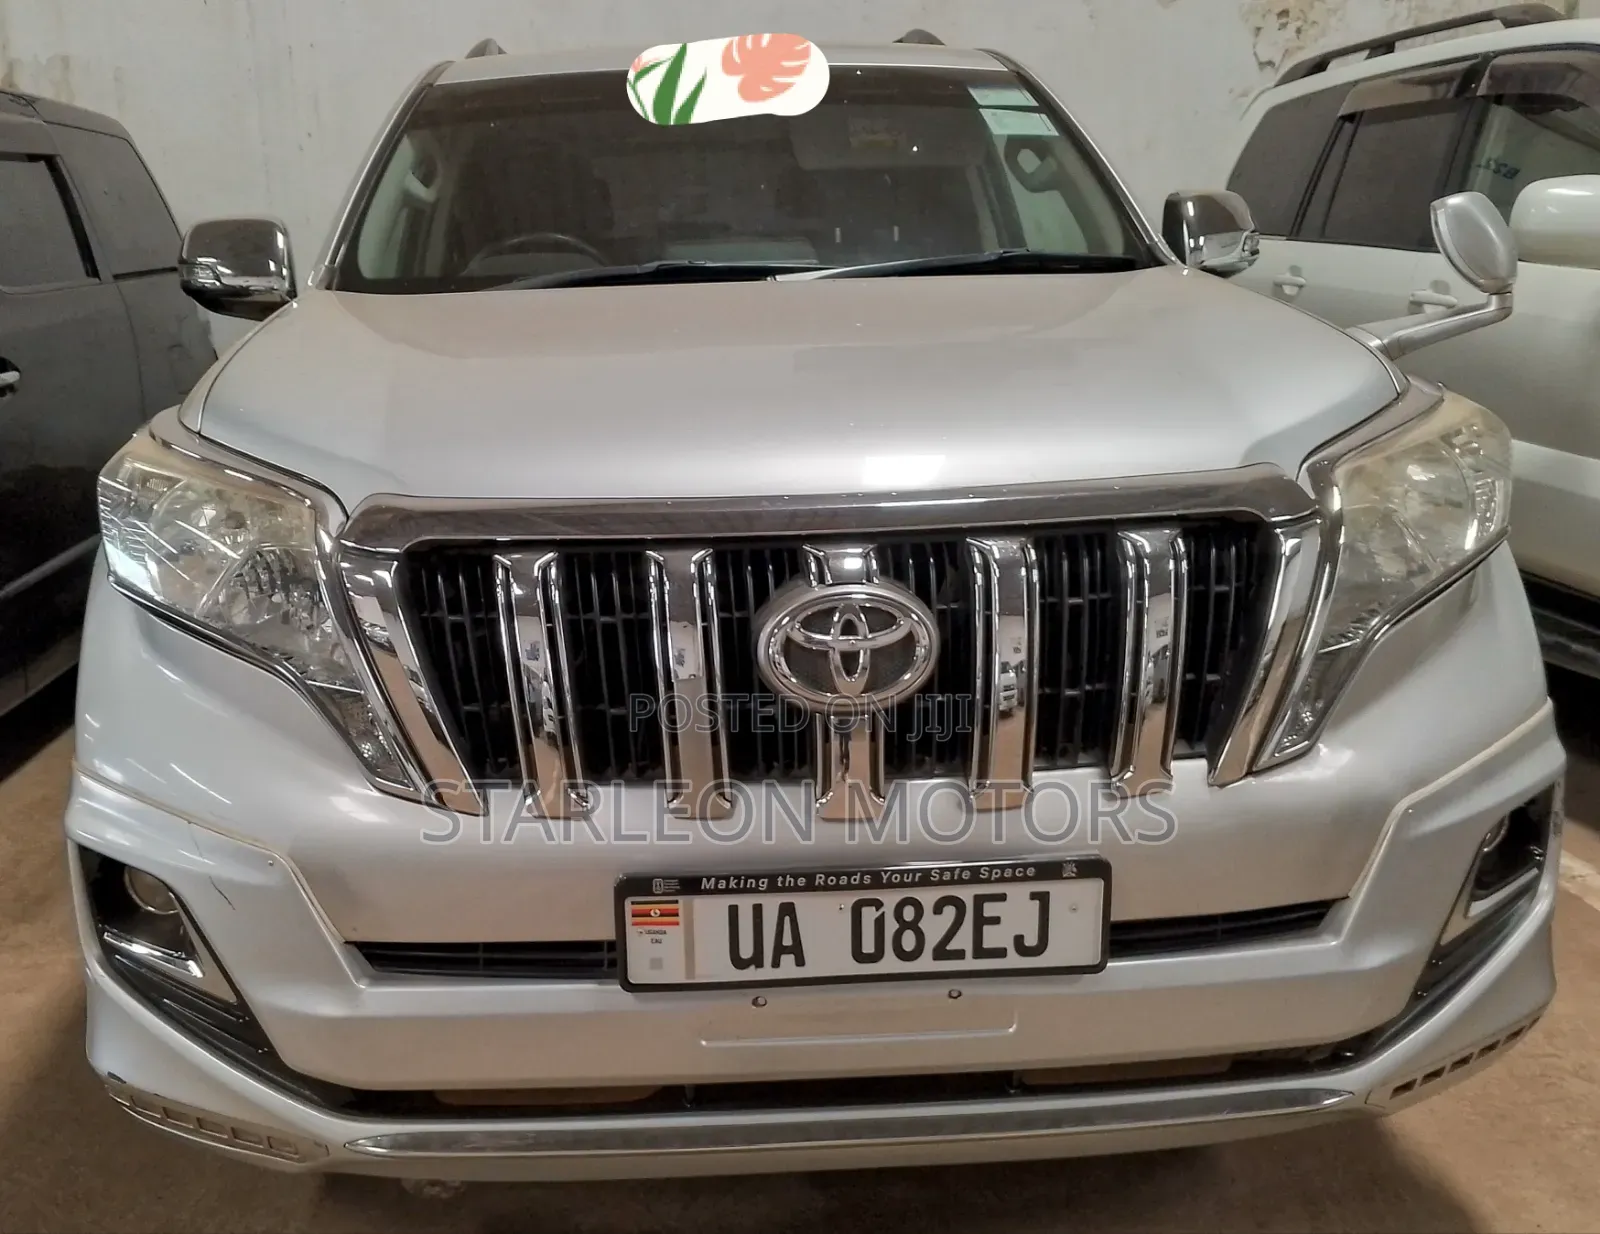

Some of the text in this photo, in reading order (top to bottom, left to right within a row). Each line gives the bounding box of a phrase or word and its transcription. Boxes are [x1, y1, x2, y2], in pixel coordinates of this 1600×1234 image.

[701, 865, 1036, 891] Making the Roads Your Safe Space
[728, 891, 1050, 971] UA 082EJ
